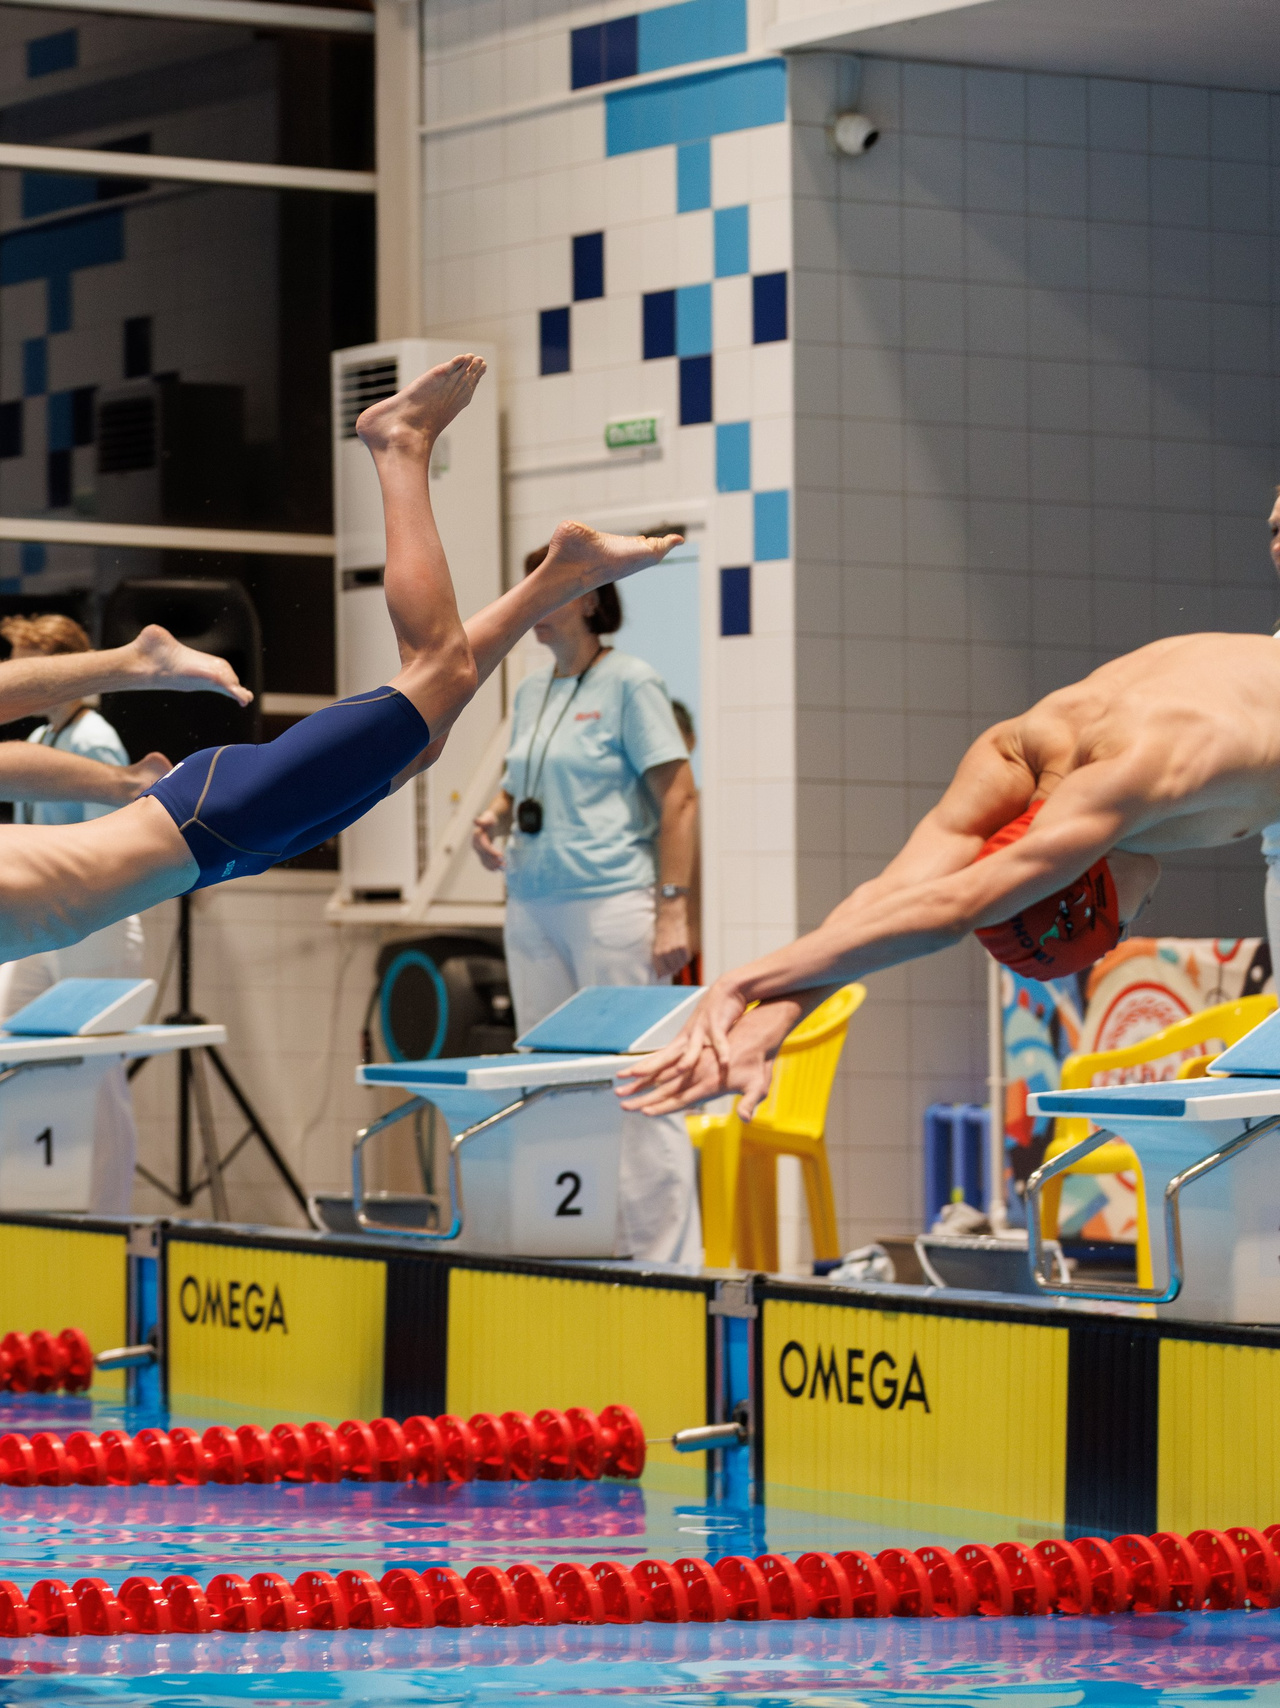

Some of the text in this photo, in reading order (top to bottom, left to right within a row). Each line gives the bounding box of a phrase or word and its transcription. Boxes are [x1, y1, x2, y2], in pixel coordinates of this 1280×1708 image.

[34, 1126, 52, 1167] 1
[555, 1171, 582, 1217] 2
[179, 1275, 288, 1335] OMEGA
[778, 1340, 932, 1414] OMEGA
